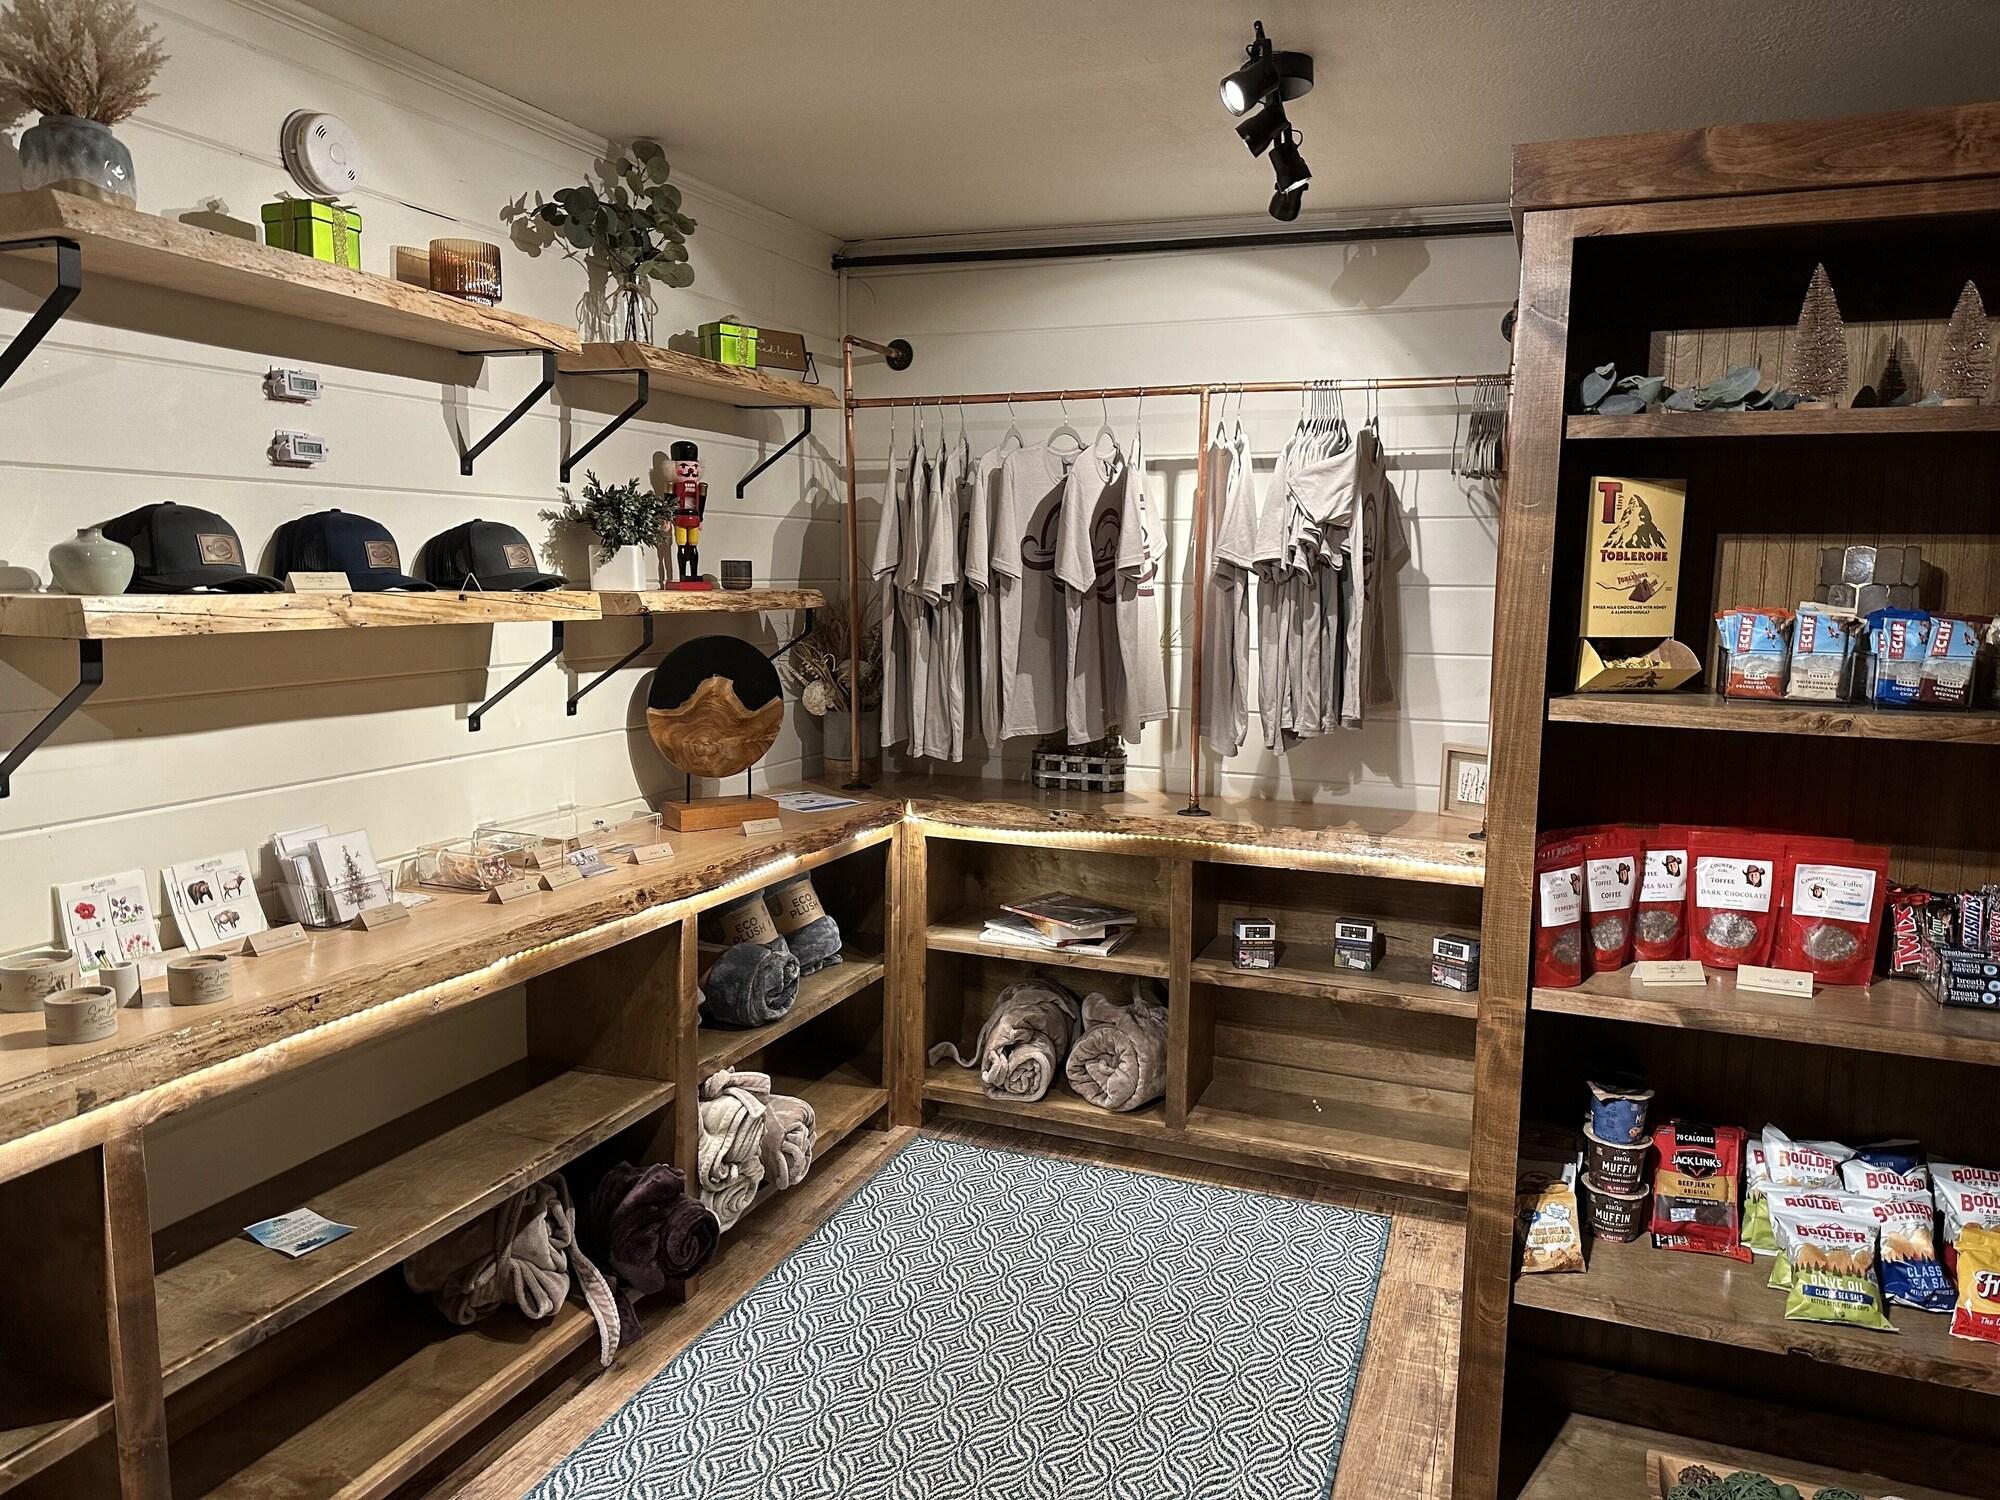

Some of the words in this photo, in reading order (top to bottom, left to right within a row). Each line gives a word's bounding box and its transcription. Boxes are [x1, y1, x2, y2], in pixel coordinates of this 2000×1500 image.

[1600, 549, 1669, 563] TOBLERONE
[1739, 616, 1753, 644] CLIF
[1801, 616, 1815, 643] CLIF
[1936, 620, 1952, 648] CLIF
[1892, 623, 1905, 649] CLIF
[1933, 686, 1964, 695] CHOCOLATE
[1710, 862, 1737, 871] COUNTRY
[1710, 877, 1736, 885] TOFFEE
[1801, 875, 1825, 885] Country
[1843, 880, 1864, 889] Toffee
[1601, 891, 1622, 899] COFFEE
[1701, 888, 1722, 896] DARK
[1724, 891, 1768, 900] CHOCOLATE
[792, 893, 812, 908] ECO
[790, 902, 819, 919] PLUSH
[735, 917, 758, 935] ECO
[732, 926, 767, 944] PLUSH
[1894, 906, 1921, 972] TWIX
[1940, 949, 1985, 959] breathsavers
[1952, 961, 1981, 969] breath
[1956, 977, 1986, 985] breath
[1950, 989, 1979, 997] breath
[1685, 1134, 1714, 1144] CALORIES
[1613, 1155, 1631, 1163] KODIAK
[1672, 1155, 1694, 1166] JACK
[1602, 1161, 1638, 1175] MUFFIN
[1794, 1165, 1829, 1175] CANYON
[1677, 1179, 1694, 1187] BEEF
[1694, 1181, 1716, 1189] JERKY
[1883, 1185, 1919, 1193] CANYON
[1683, 1188, 1711, 1196] ORIGINAL
[1605, 1203, 1623, 1212] KODIAK
[1595, 1208, 1631, 1223] MUFFIN
[1872, 1202, 1934, 1224] BOULDER
[1892, 1214, 1926, 1222] CANYON
[1796, 1223, 1867, 1243] BOULDER
[1813, 1235, 1851, 1243] CANYON
[1810, 1274, 1843, 1290] OLIVE
[1848, 1281, 1866, 1293] OIL
[1838, 1291, 1849, 1300] SEA
[1811, 1298, 1826, 1306] KETTLE
